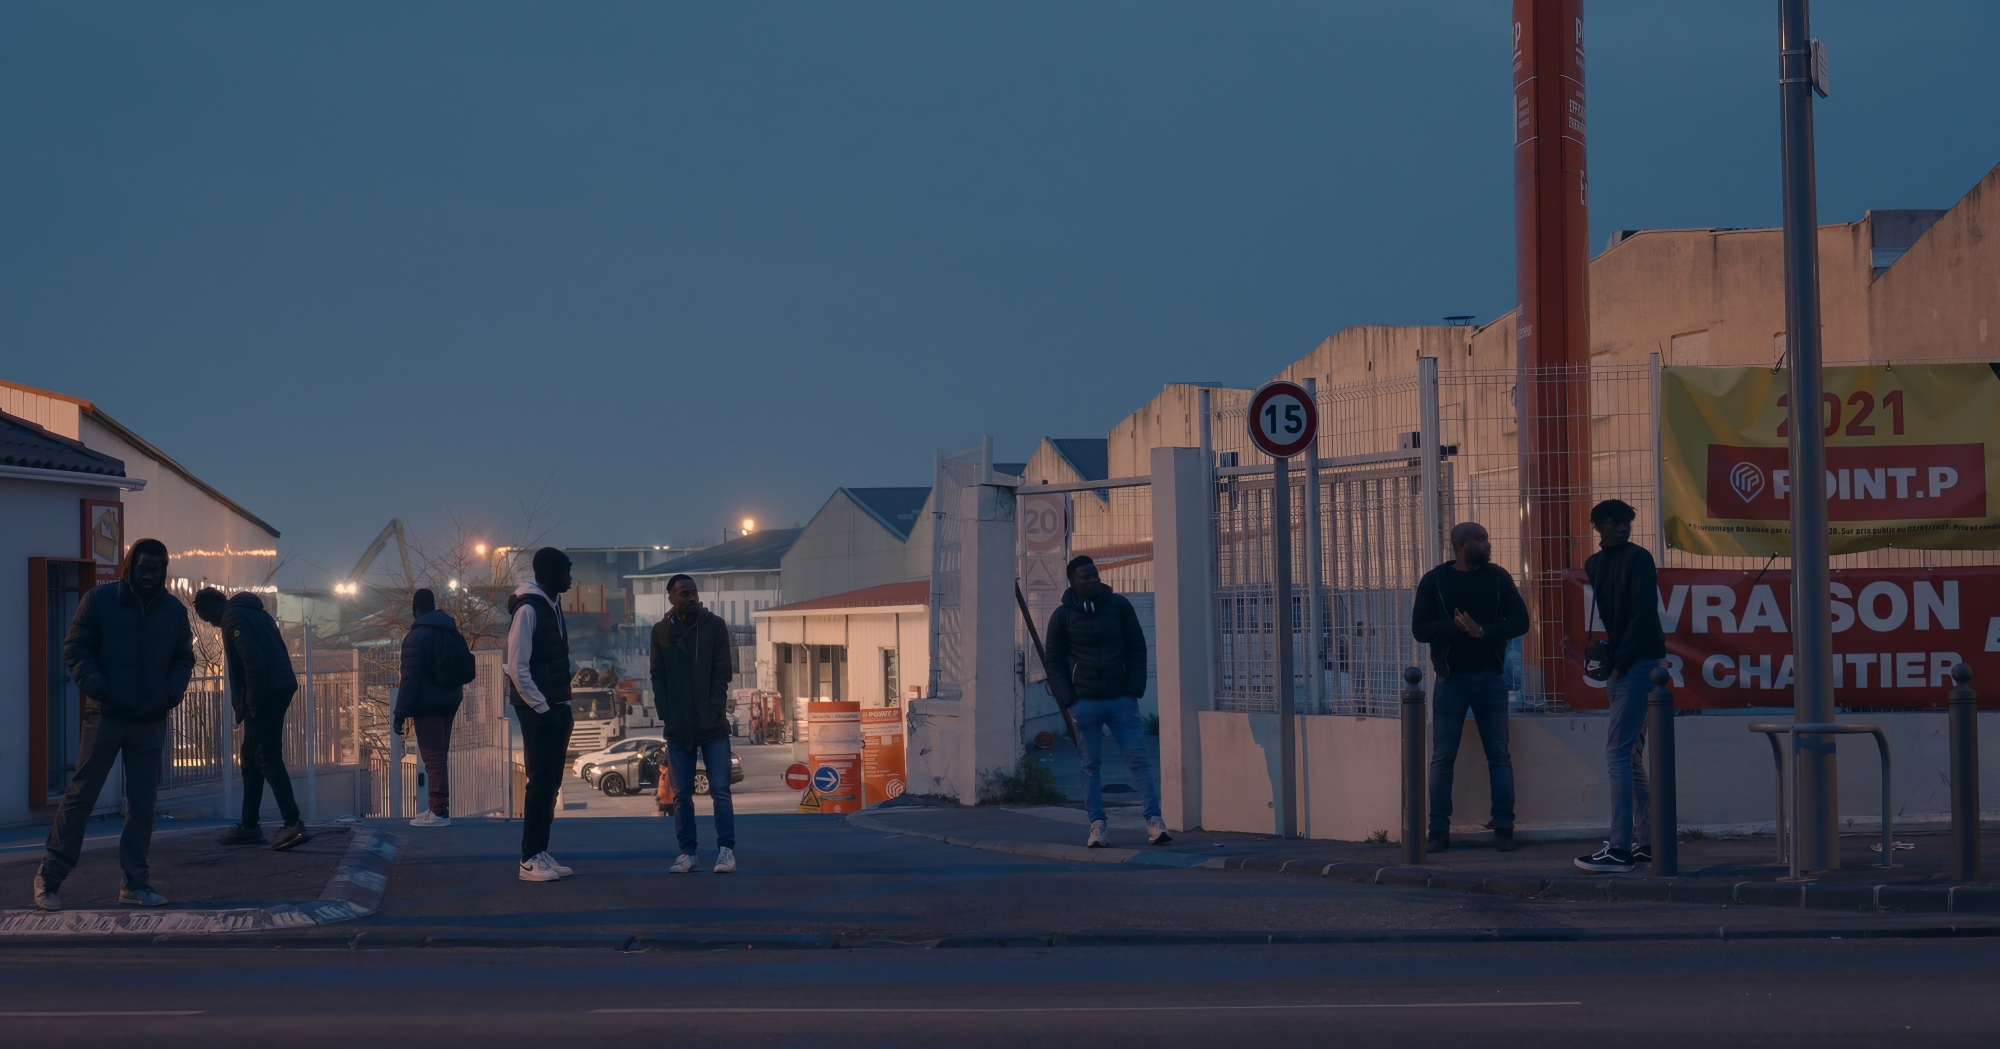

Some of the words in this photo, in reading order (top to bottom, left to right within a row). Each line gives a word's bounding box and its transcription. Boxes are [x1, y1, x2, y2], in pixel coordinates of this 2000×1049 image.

[1265, 404, 1303, 434] 15
[1027, 508, 1058, 535] 20
[1735, 525, 1744, 533] de
[1746, 525, 1769, 534] baisse
[1856, 527, 1871, 535] prix
[1872, 526, 1894, 535] public
[1583, 580, 1960, 634] LVRASON
[1702, 651, 1963, 690] CHATIER
